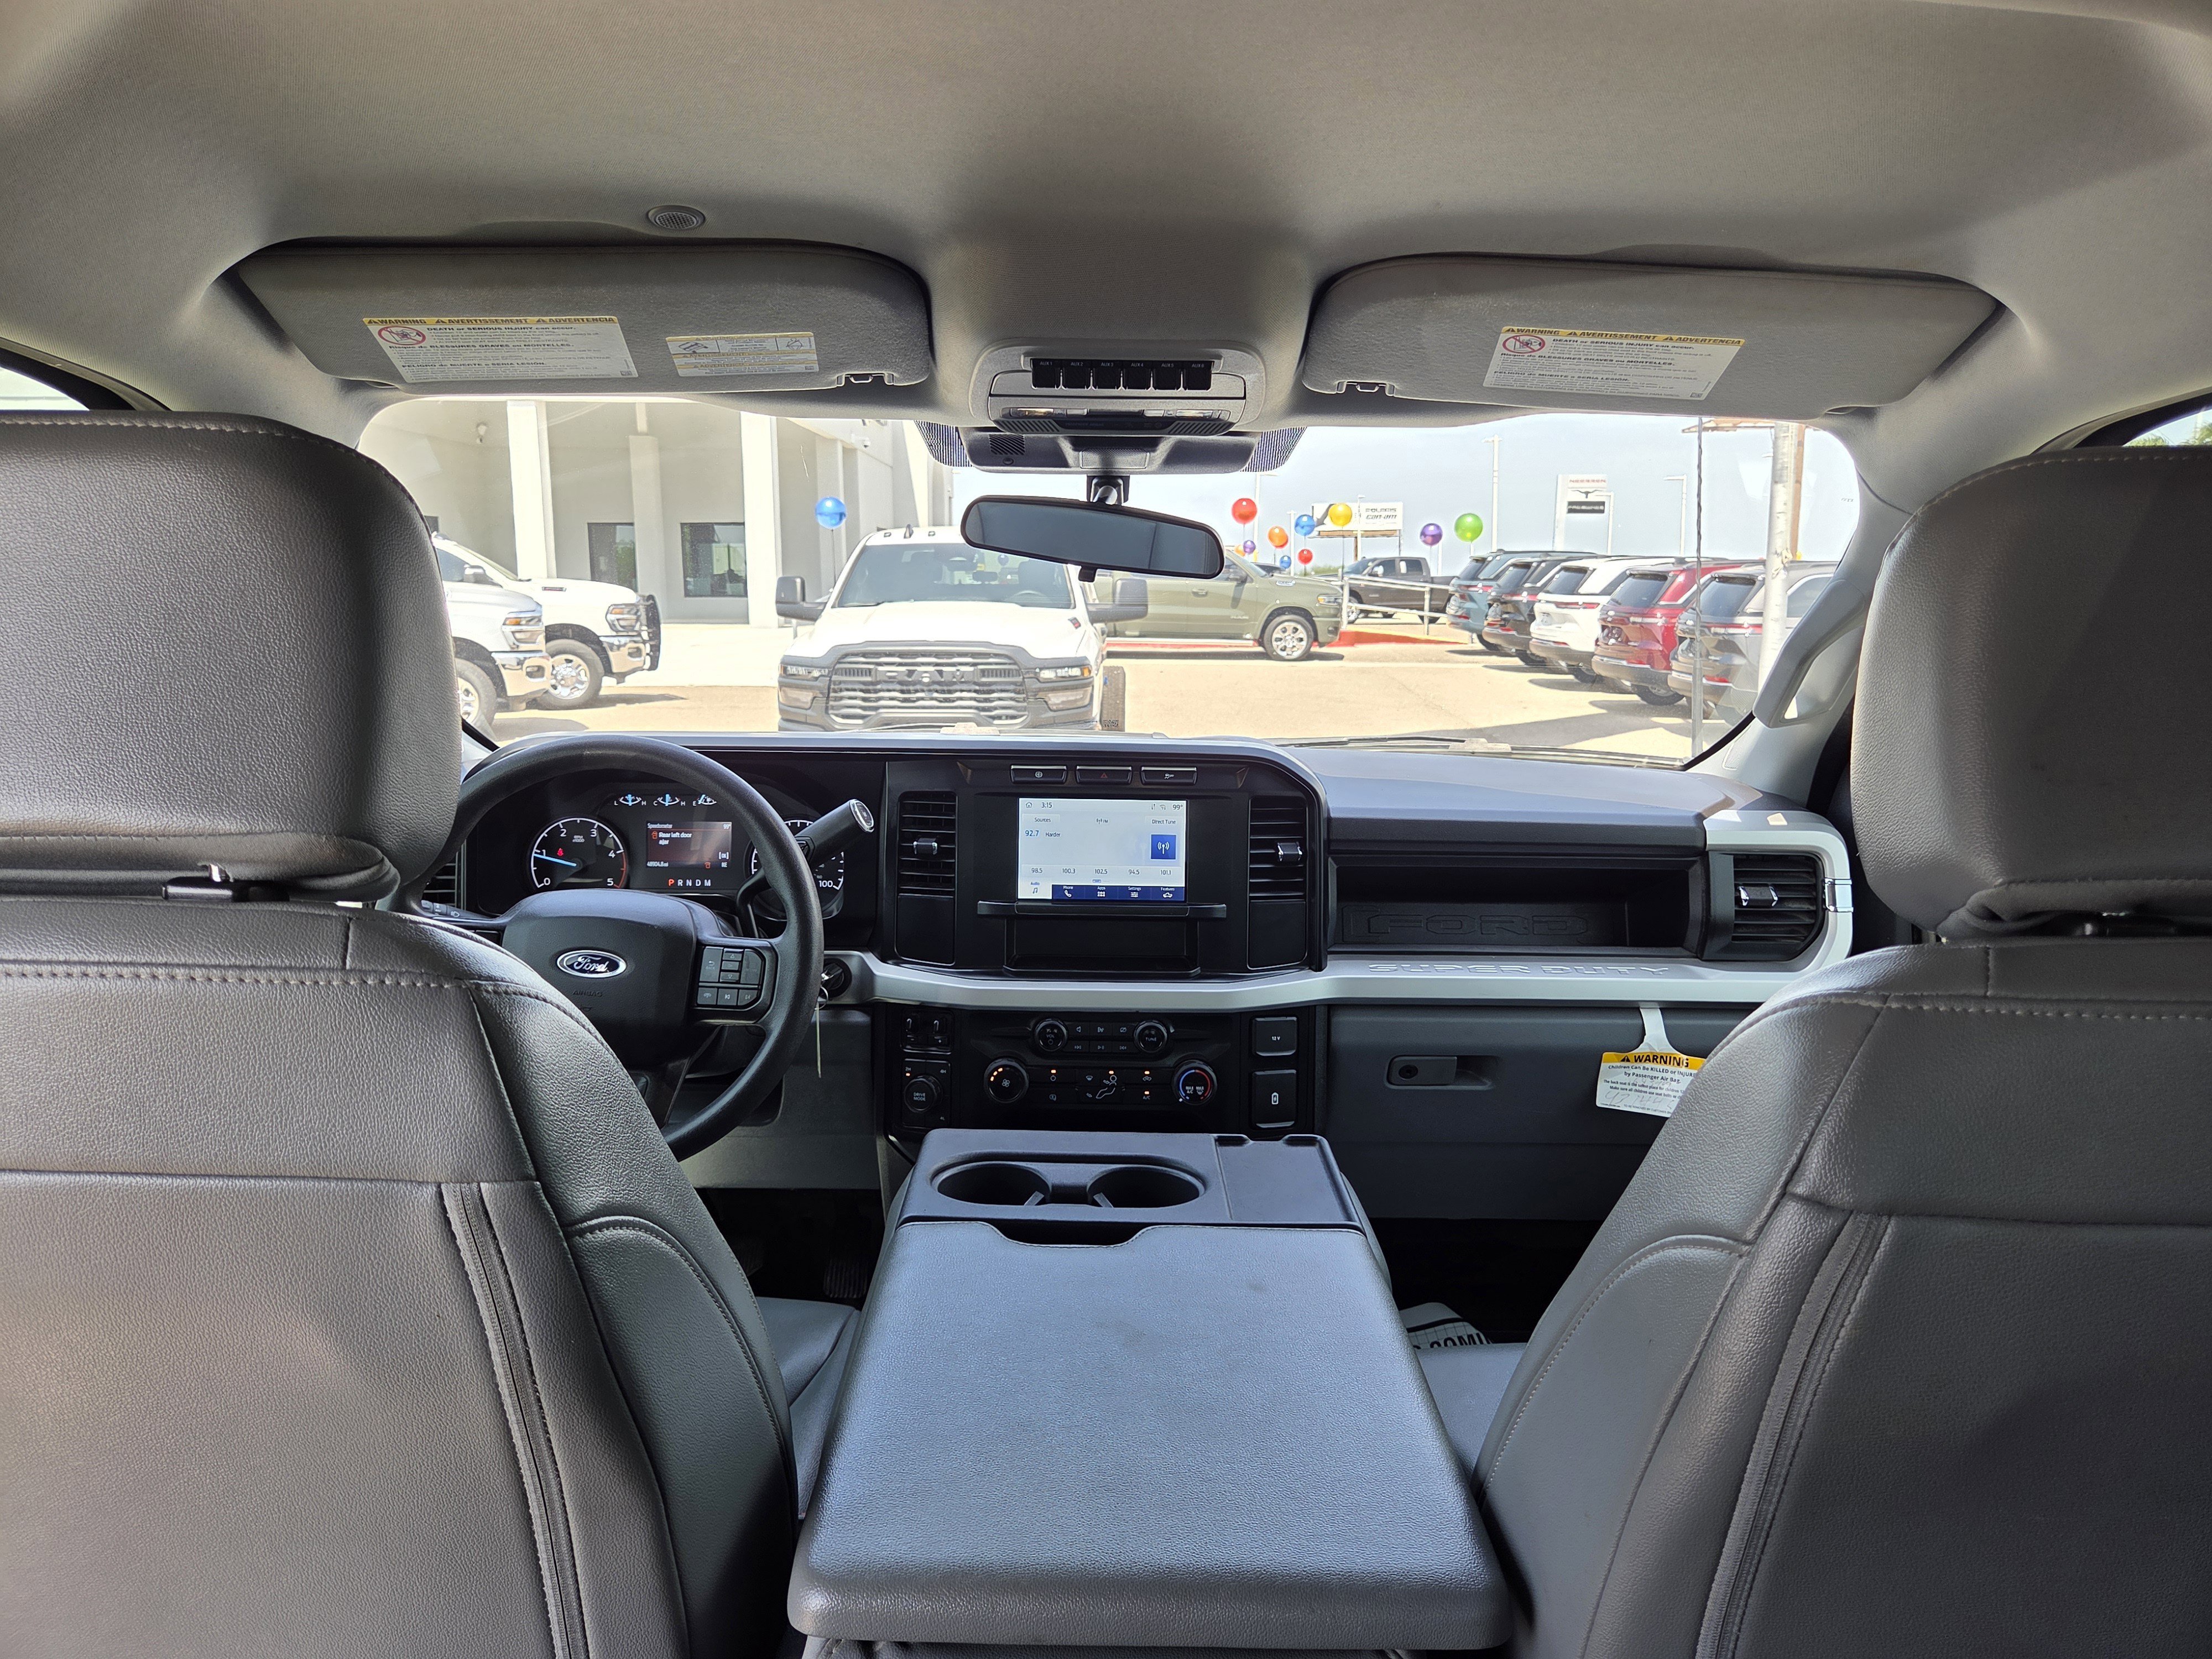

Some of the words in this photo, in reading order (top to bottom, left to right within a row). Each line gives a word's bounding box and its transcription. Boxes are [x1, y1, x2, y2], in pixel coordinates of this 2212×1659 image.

[1579, 331, 1658, 340] AVERTISSEMENT
[560, 828, 567, 837] 2
[589, 829, 597, 837] 3
[608, 850, 615, 858] 4
[607, 878, 614, 886] 5
[1368, 914, 1588, 936] FORD
[573, 955, 609, 972] Ford
[1368, 964, 1530, 974] SUPER
[1541, 966, 1670, 975] DUTY
[572, 989, 603, 998] AIRBAG
[1634, 1055, 1689, 1067] WARNING
[1632, 1072, 1659, 1081] Passenger
